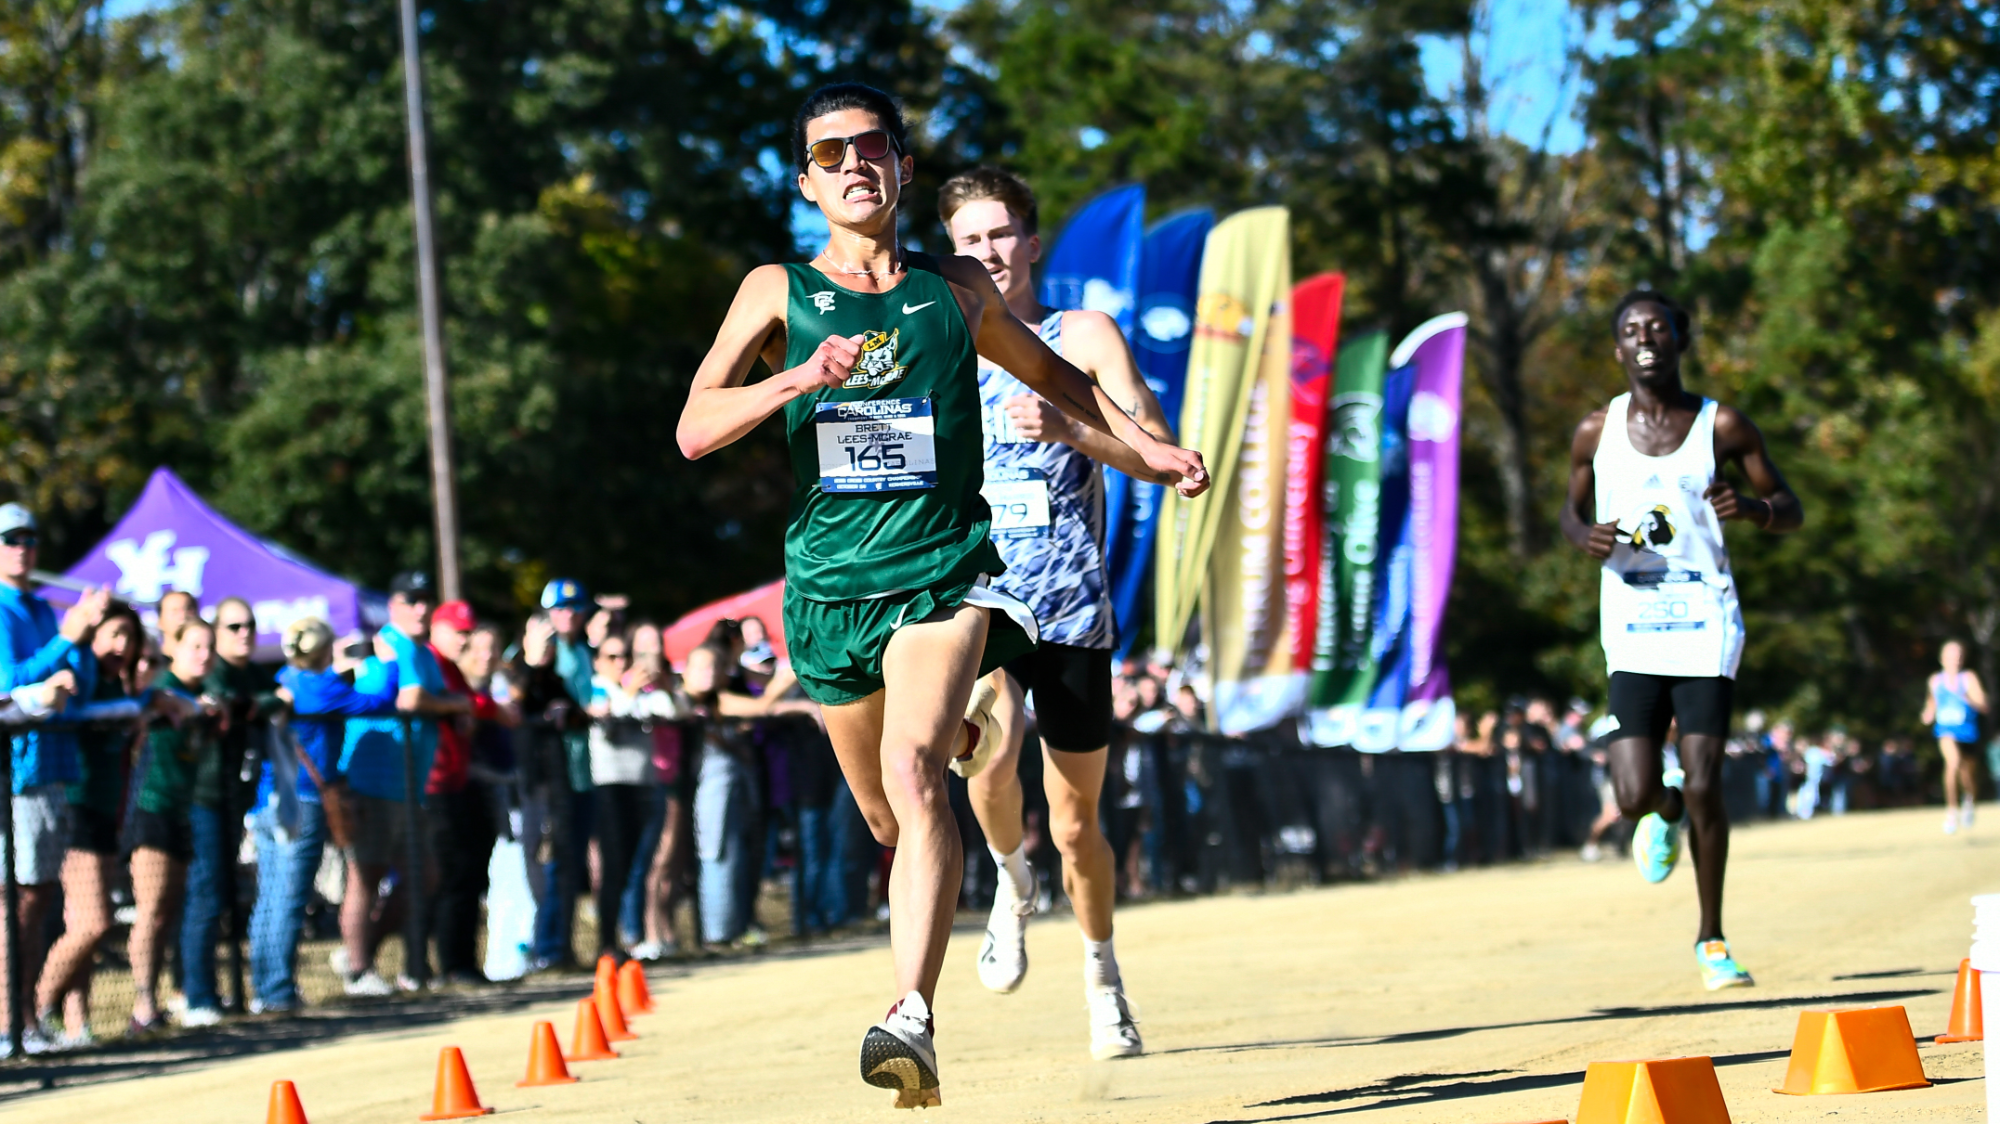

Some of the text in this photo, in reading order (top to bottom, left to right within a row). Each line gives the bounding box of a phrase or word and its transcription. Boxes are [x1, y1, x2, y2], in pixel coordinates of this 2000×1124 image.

[838, 403, 913, 419] CAROLINAS
[855, 422, 892, 433] BRETT
[845, 443, 906, 471] 165
[1638, 601, 1688, 619] 250
